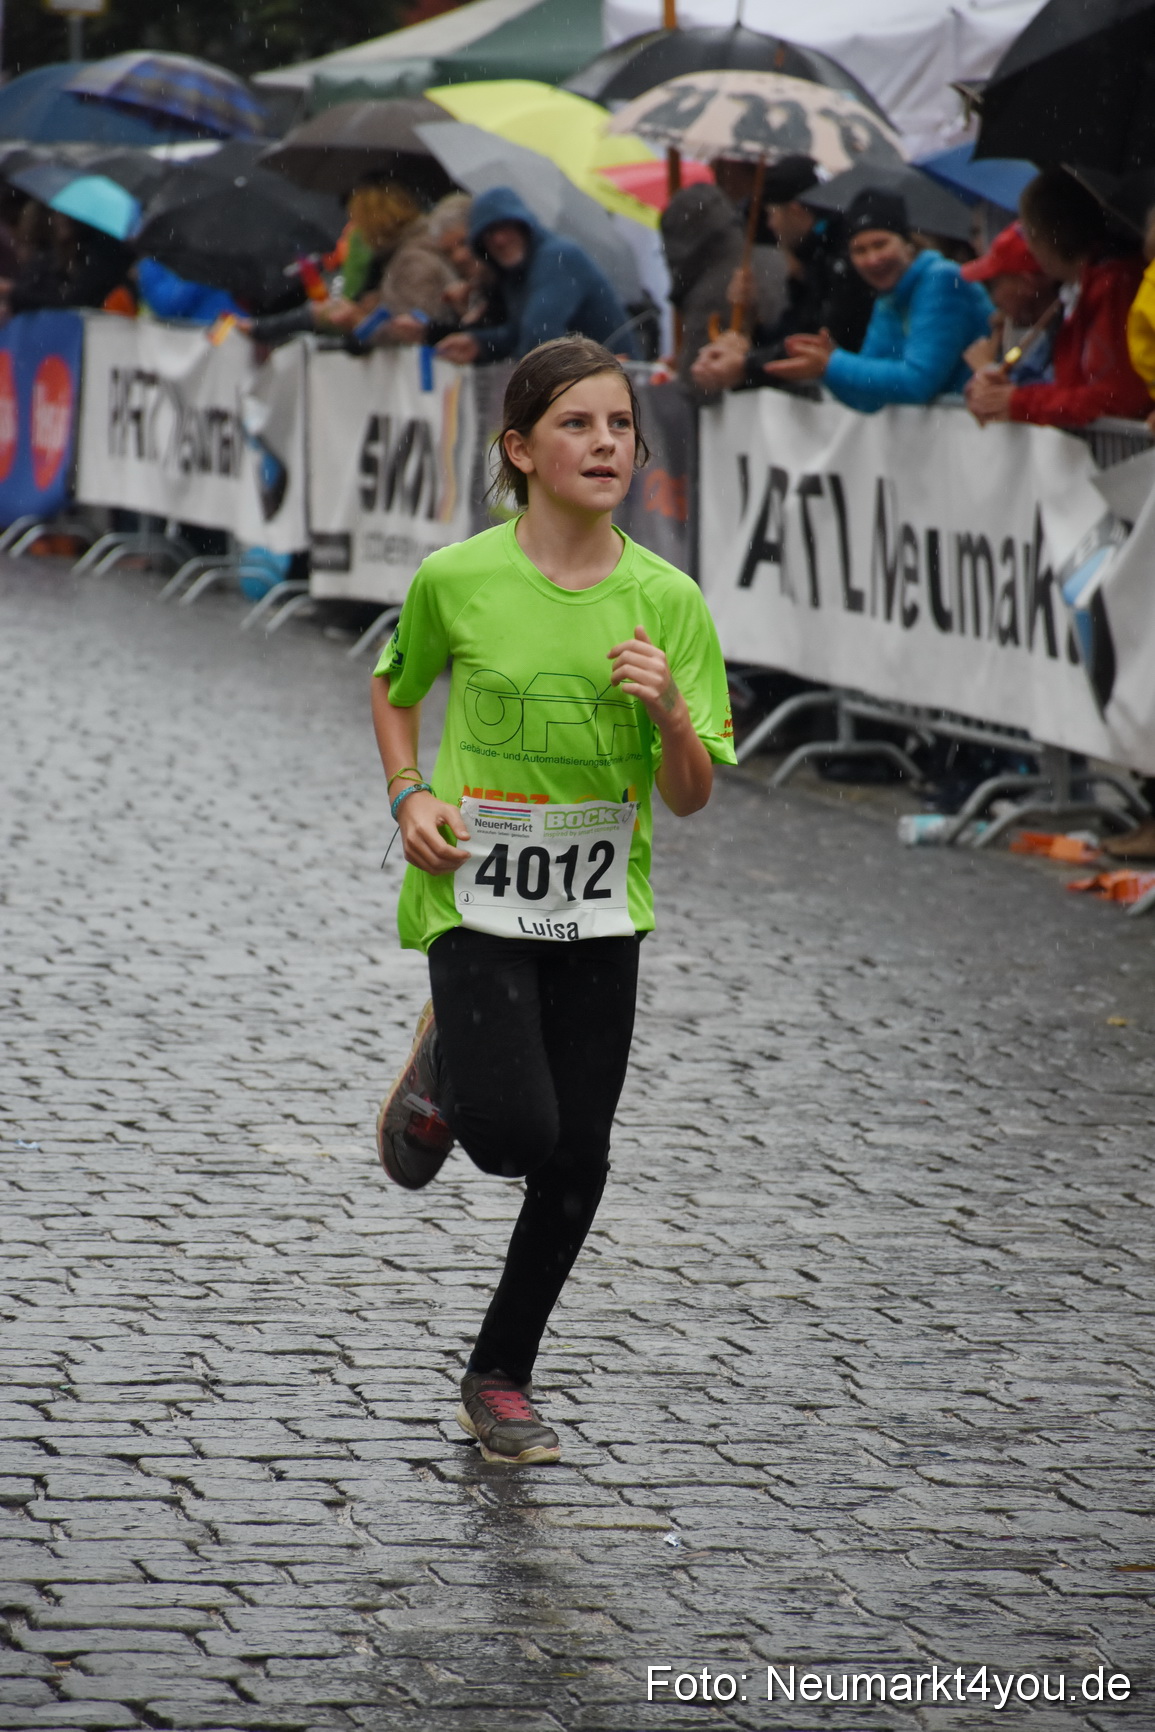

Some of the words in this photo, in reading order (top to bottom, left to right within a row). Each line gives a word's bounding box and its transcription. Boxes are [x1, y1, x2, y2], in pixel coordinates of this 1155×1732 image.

[503, 752, 521, 761] und
[475, 818, 533, 833] NeuerMarkt
[544, 807, 624, 831] BOCK
[475, 840, 615, 902] 4012
[518, 916, 579, 940] Luisa
